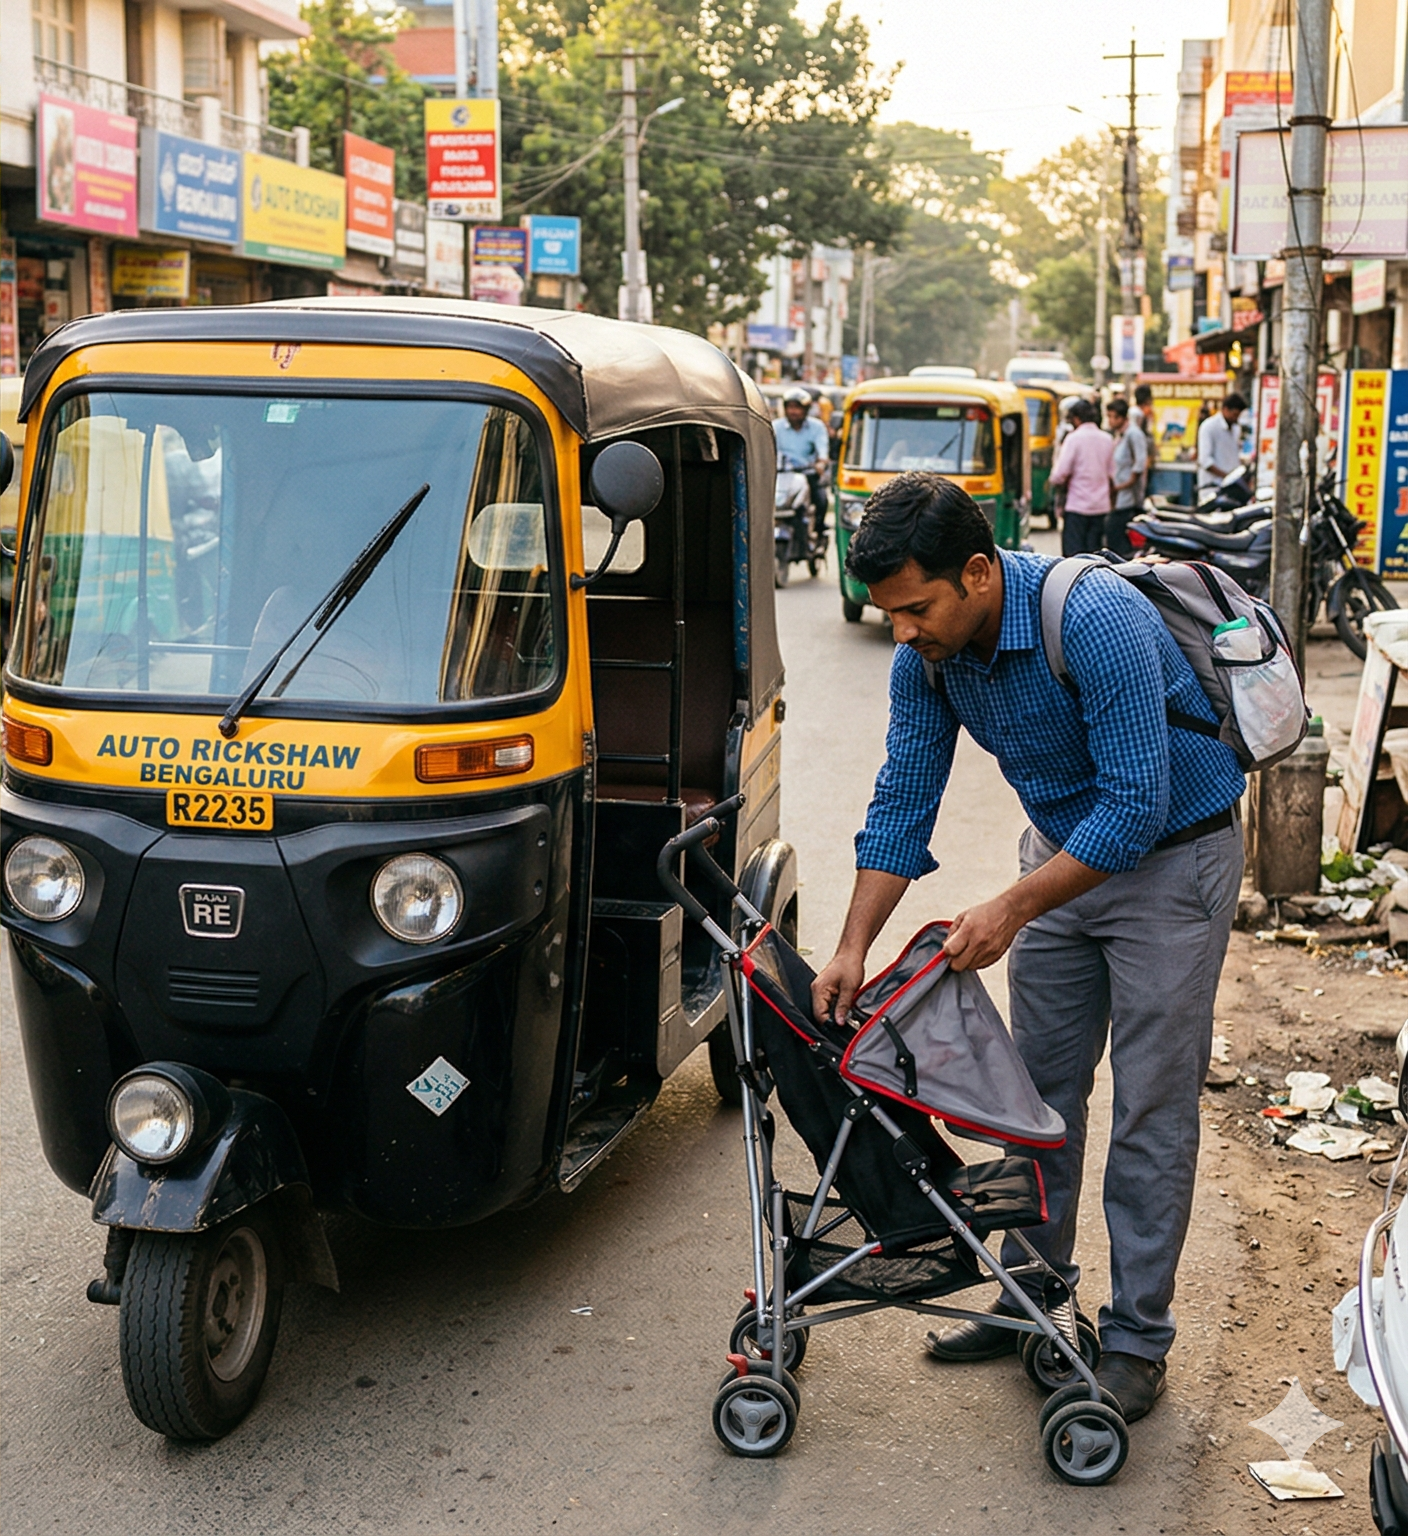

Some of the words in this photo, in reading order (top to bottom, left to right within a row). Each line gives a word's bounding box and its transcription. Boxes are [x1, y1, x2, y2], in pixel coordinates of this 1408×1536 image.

[97, 734, 180, 760] AUTO
[192, 738, 361, 770] RICKSHAW
[139, 763, 306, 790] BENGALURU
[173, 793, 266, 825] R2235
[194, 893, 228, 903] BAJAJ
[193, 903, 231, 925] RE
